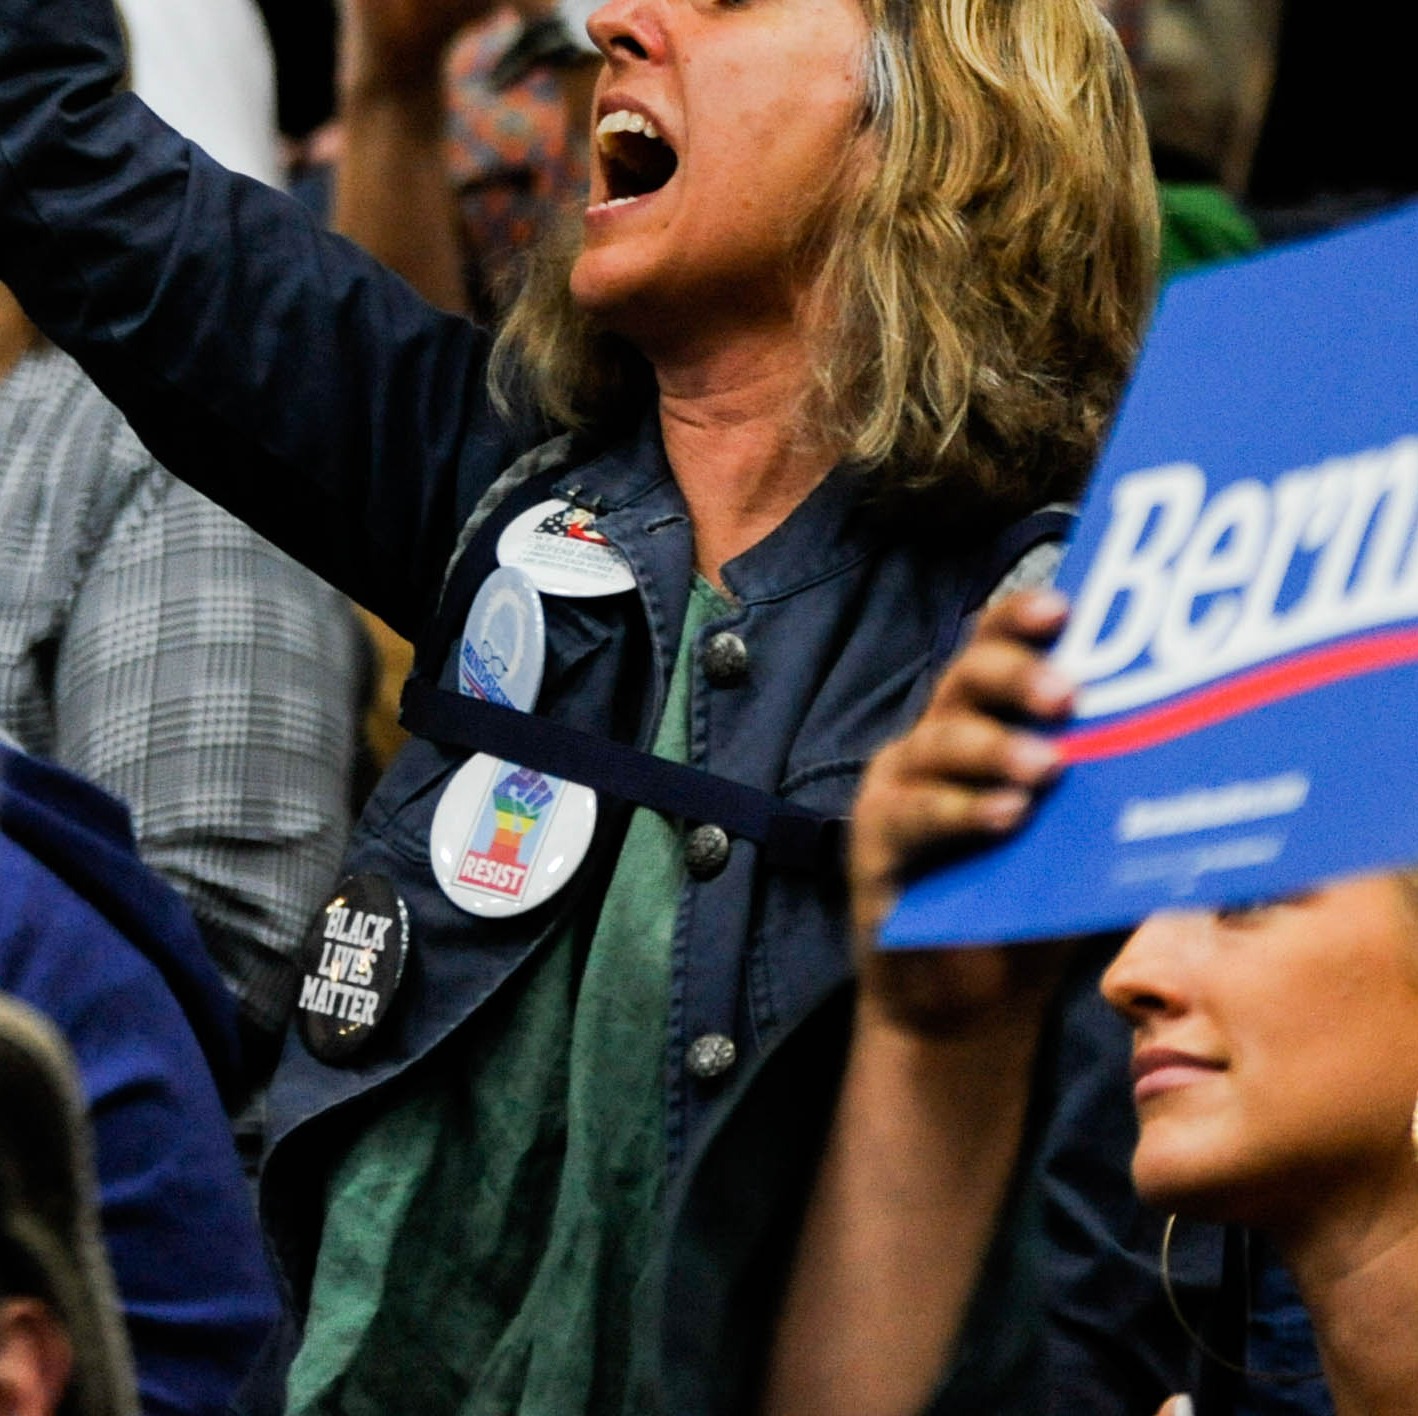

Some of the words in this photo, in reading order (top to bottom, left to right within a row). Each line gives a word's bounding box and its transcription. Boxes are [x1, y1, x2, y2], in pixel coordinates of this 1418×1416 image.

[461, 855, 526, 891] RESIST
[324, 905, 393, 952] BLACK
[317, 941, 378, 986] LIVES
[298, 974, 380, 1026] MATTER
